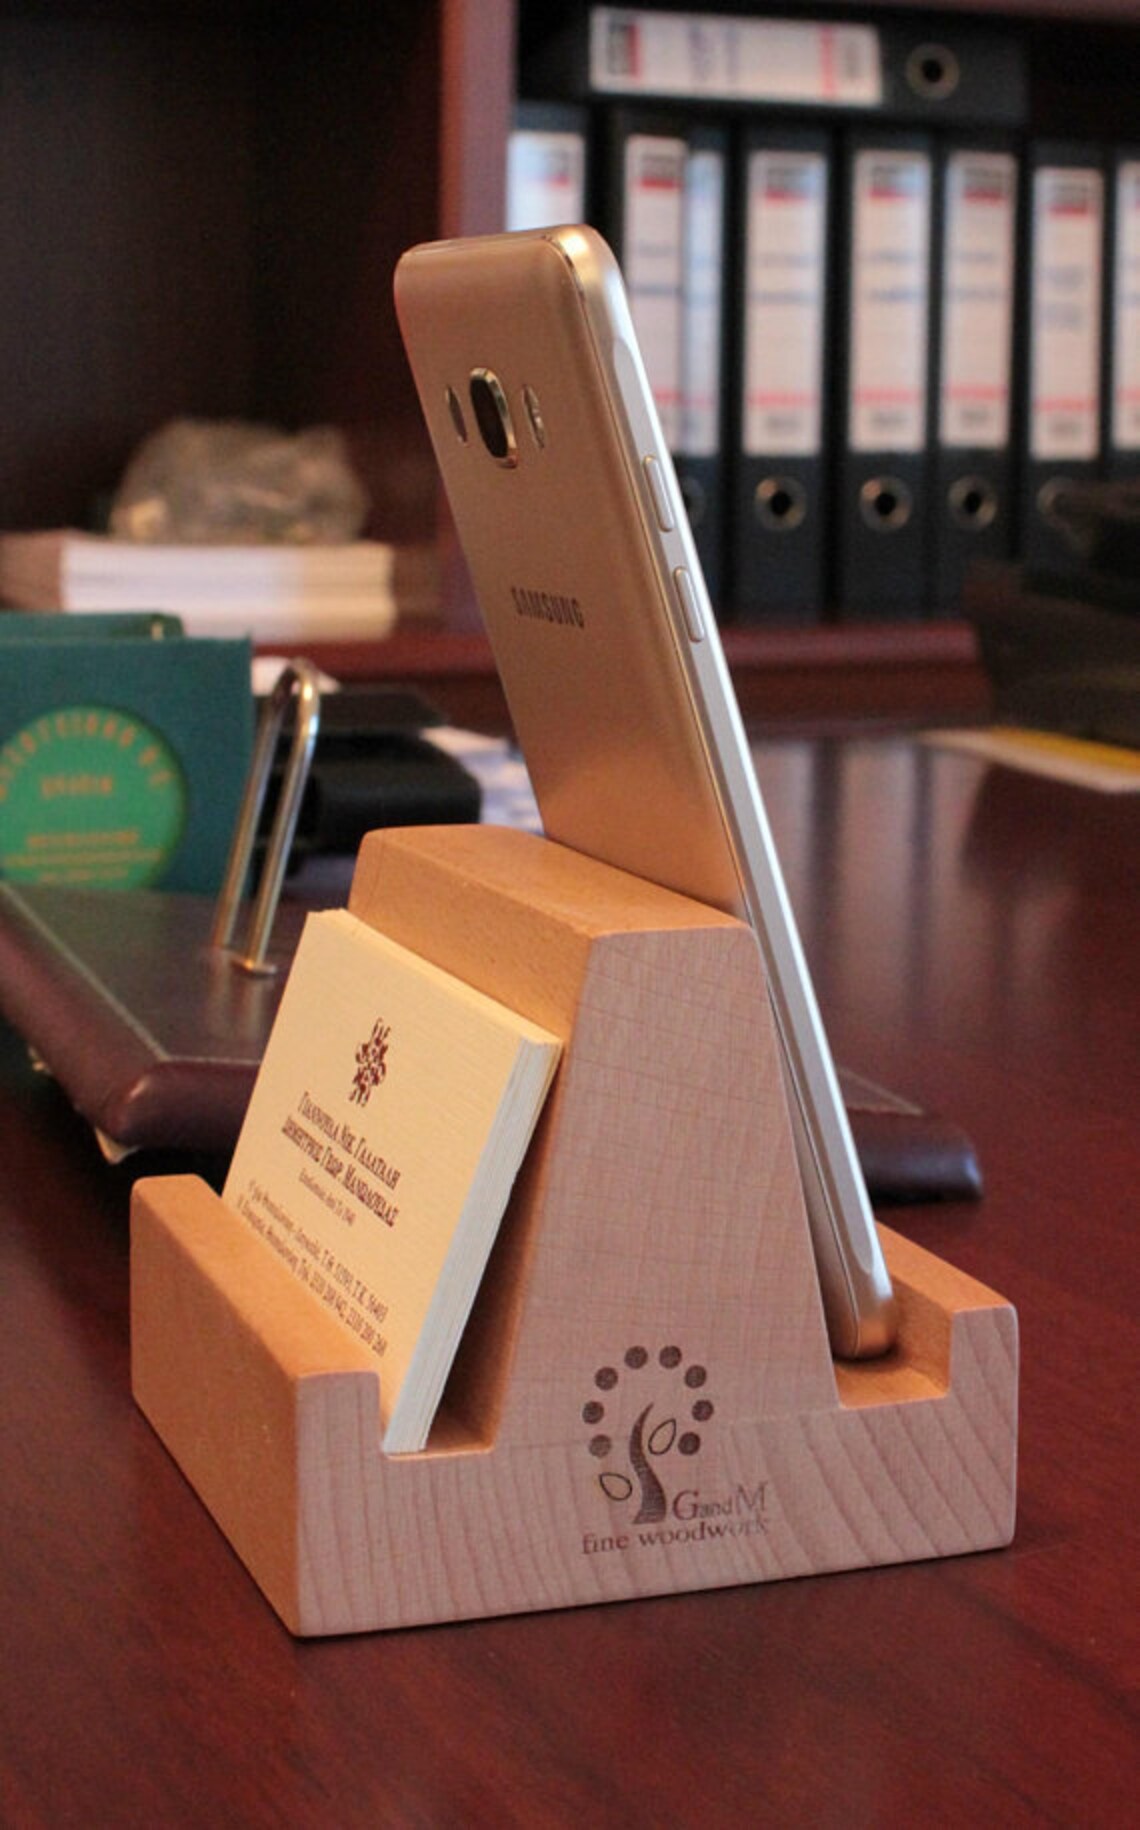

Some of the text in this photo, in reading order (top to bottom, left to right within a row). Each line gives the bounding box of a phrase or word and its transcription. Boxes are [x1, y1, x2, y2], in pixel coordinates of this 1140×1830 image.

[510, 585, 584, 630] SAMSUNG
[672, 1480, 769, 1521] GandM
[582, 1514, 770, 1555] fine woodwork
